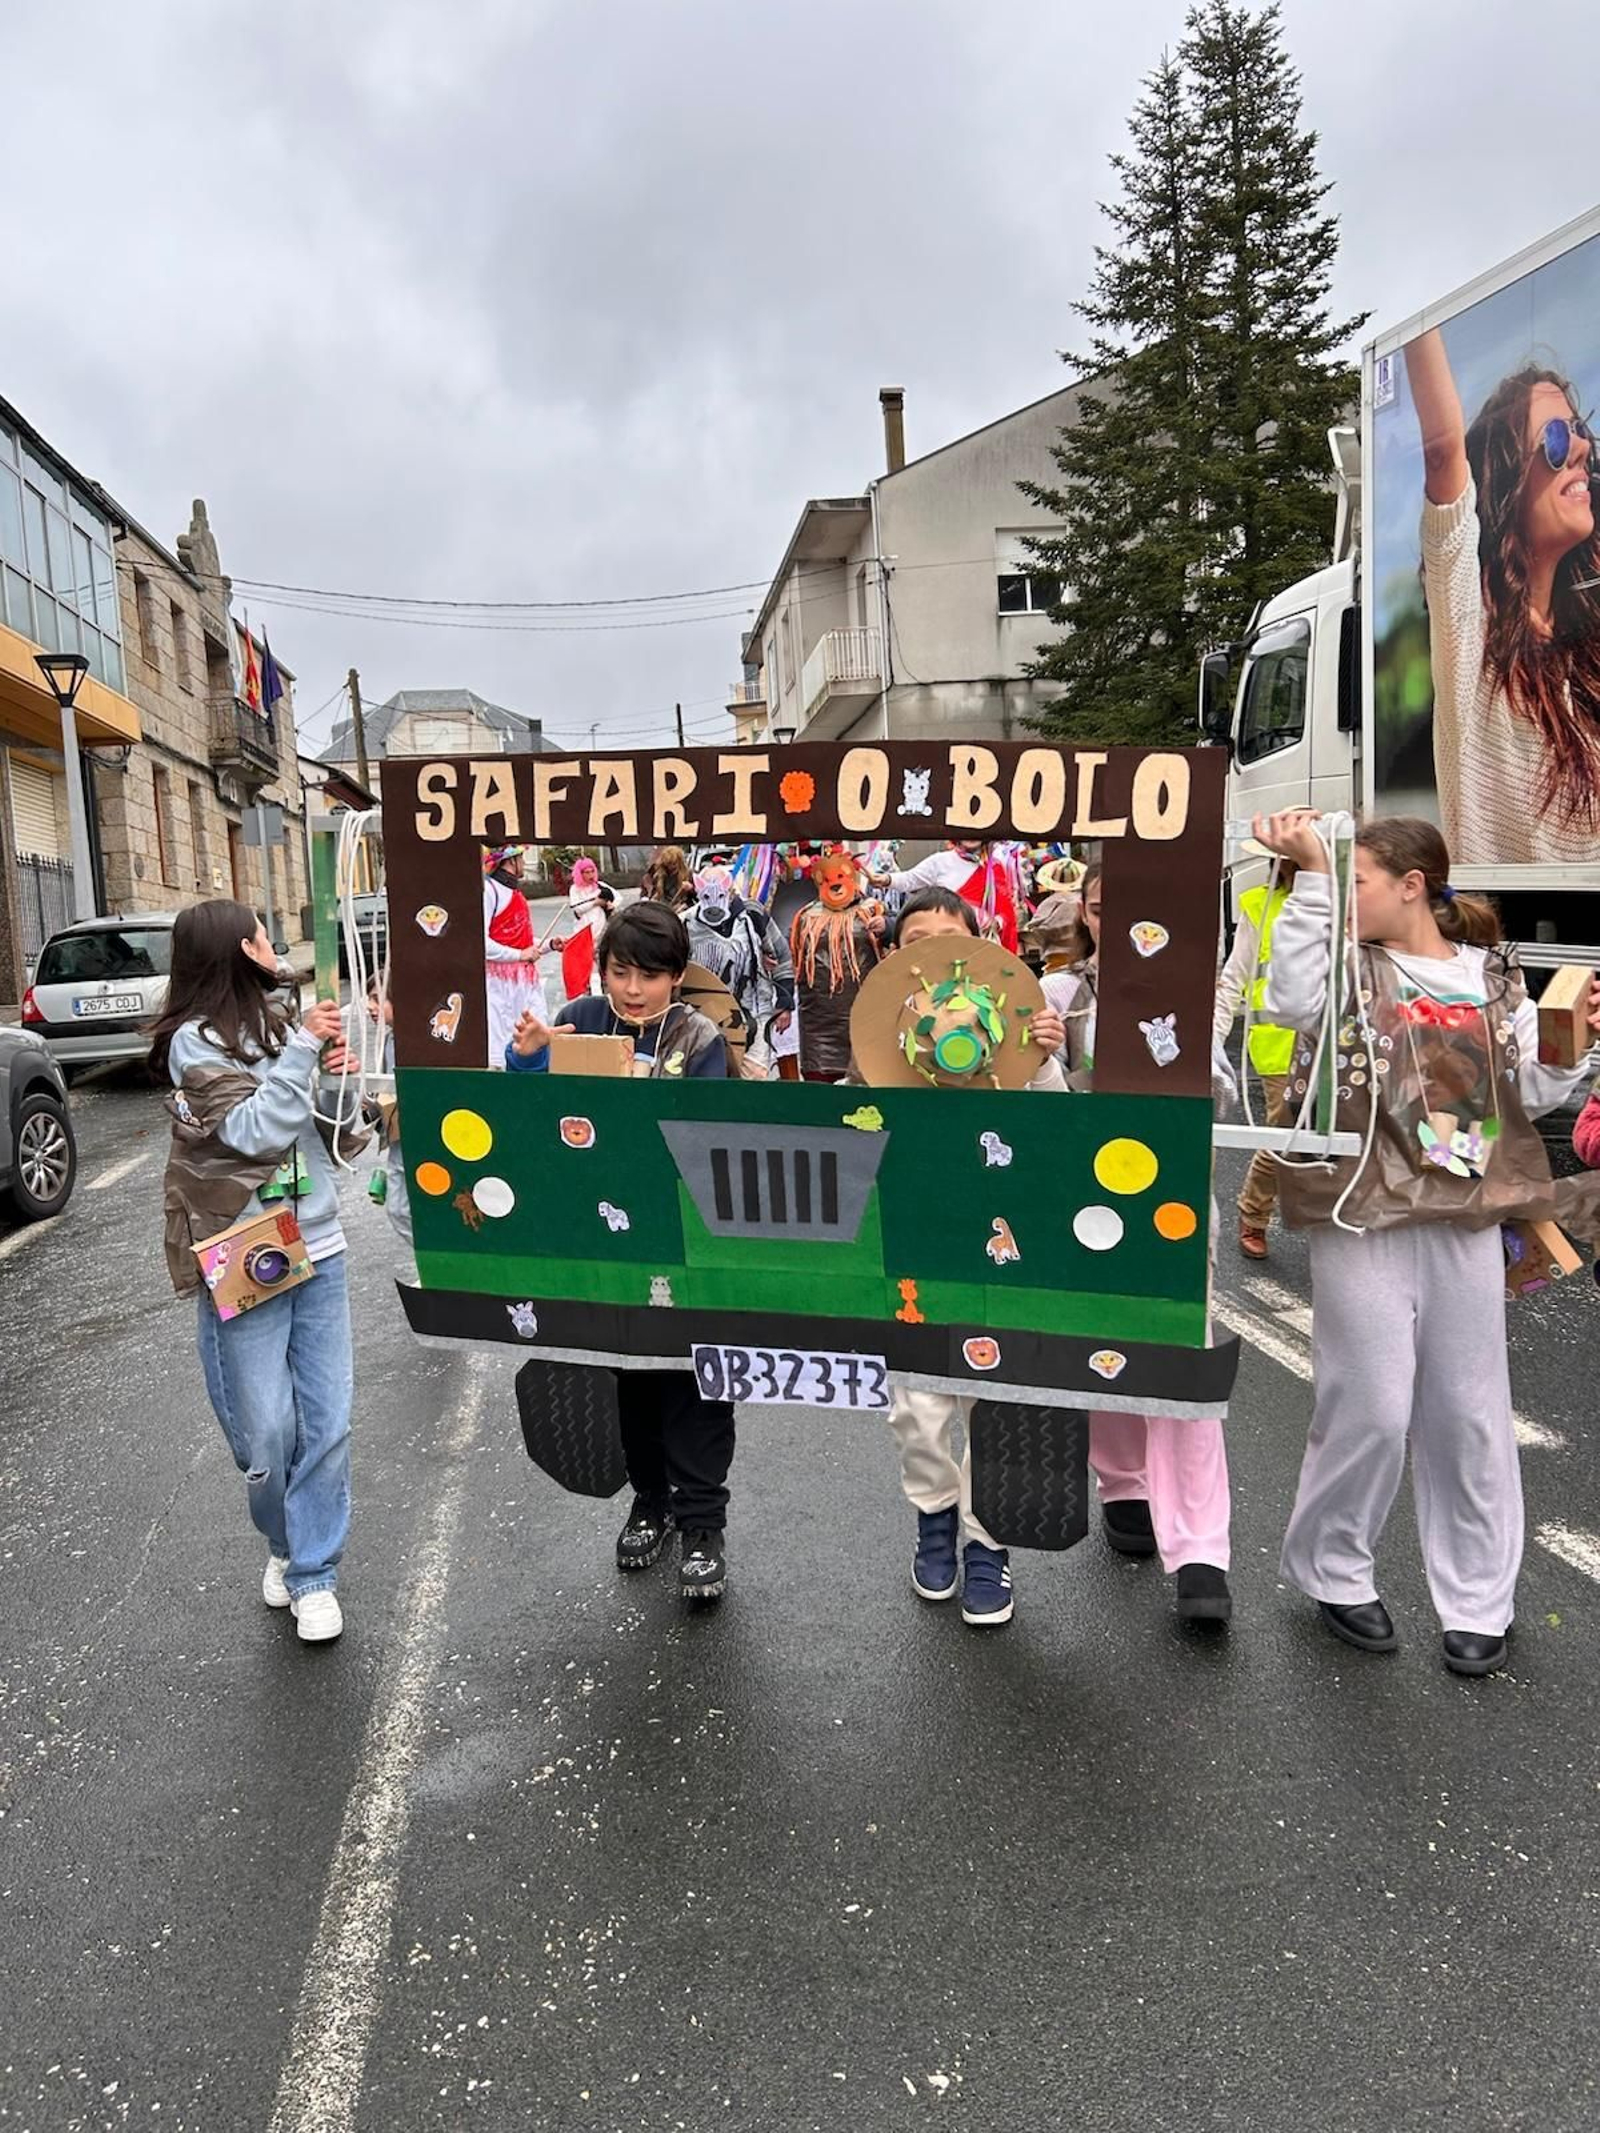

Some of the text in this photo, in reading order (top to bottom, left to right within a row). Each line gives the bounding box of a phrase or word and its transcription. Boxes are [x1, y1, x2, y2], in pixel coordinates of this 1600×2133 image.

[415, 745, 1191, 841] SAFARI O BOLO
[83, 999, 111, 1011] 2675
